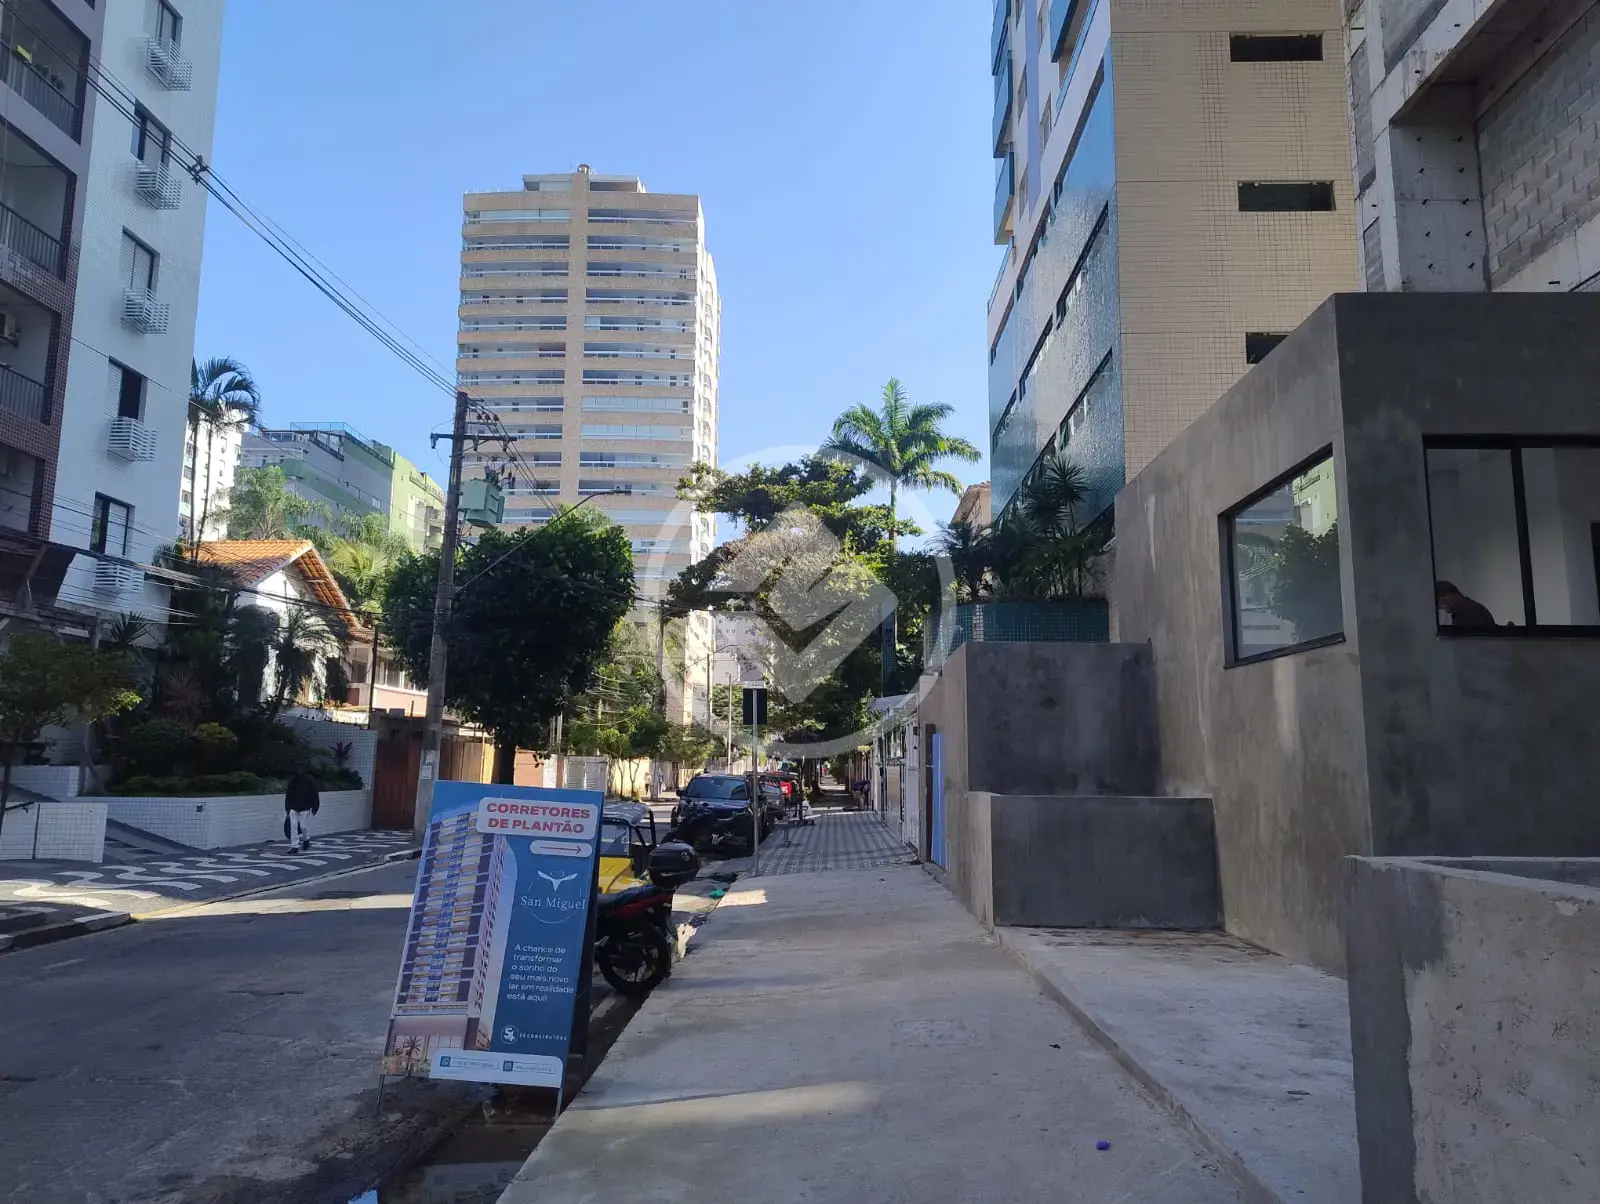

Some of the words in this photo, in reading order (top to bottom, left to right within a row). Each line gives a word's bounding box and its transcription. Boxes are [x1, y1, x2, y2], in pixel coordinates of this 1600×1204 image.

[487, 803, 590, 819] CORRETORES
[488, 818, 509, 828] DE
[512, 820, 584, 833] PLANTÃO
[521, 896, 541, 907] San
[546, 897, 586, 911] Miguel
[523, 945, 554, 954] chance
[513, 954, 563, 963] transformar
[519, 964, 544, 972] sonho
[547, 965, 558, 973] do
[527, 974, 547, 982] mais
[536, 985, 574, 994] realidade
[507, 992, 525, 1000] está
